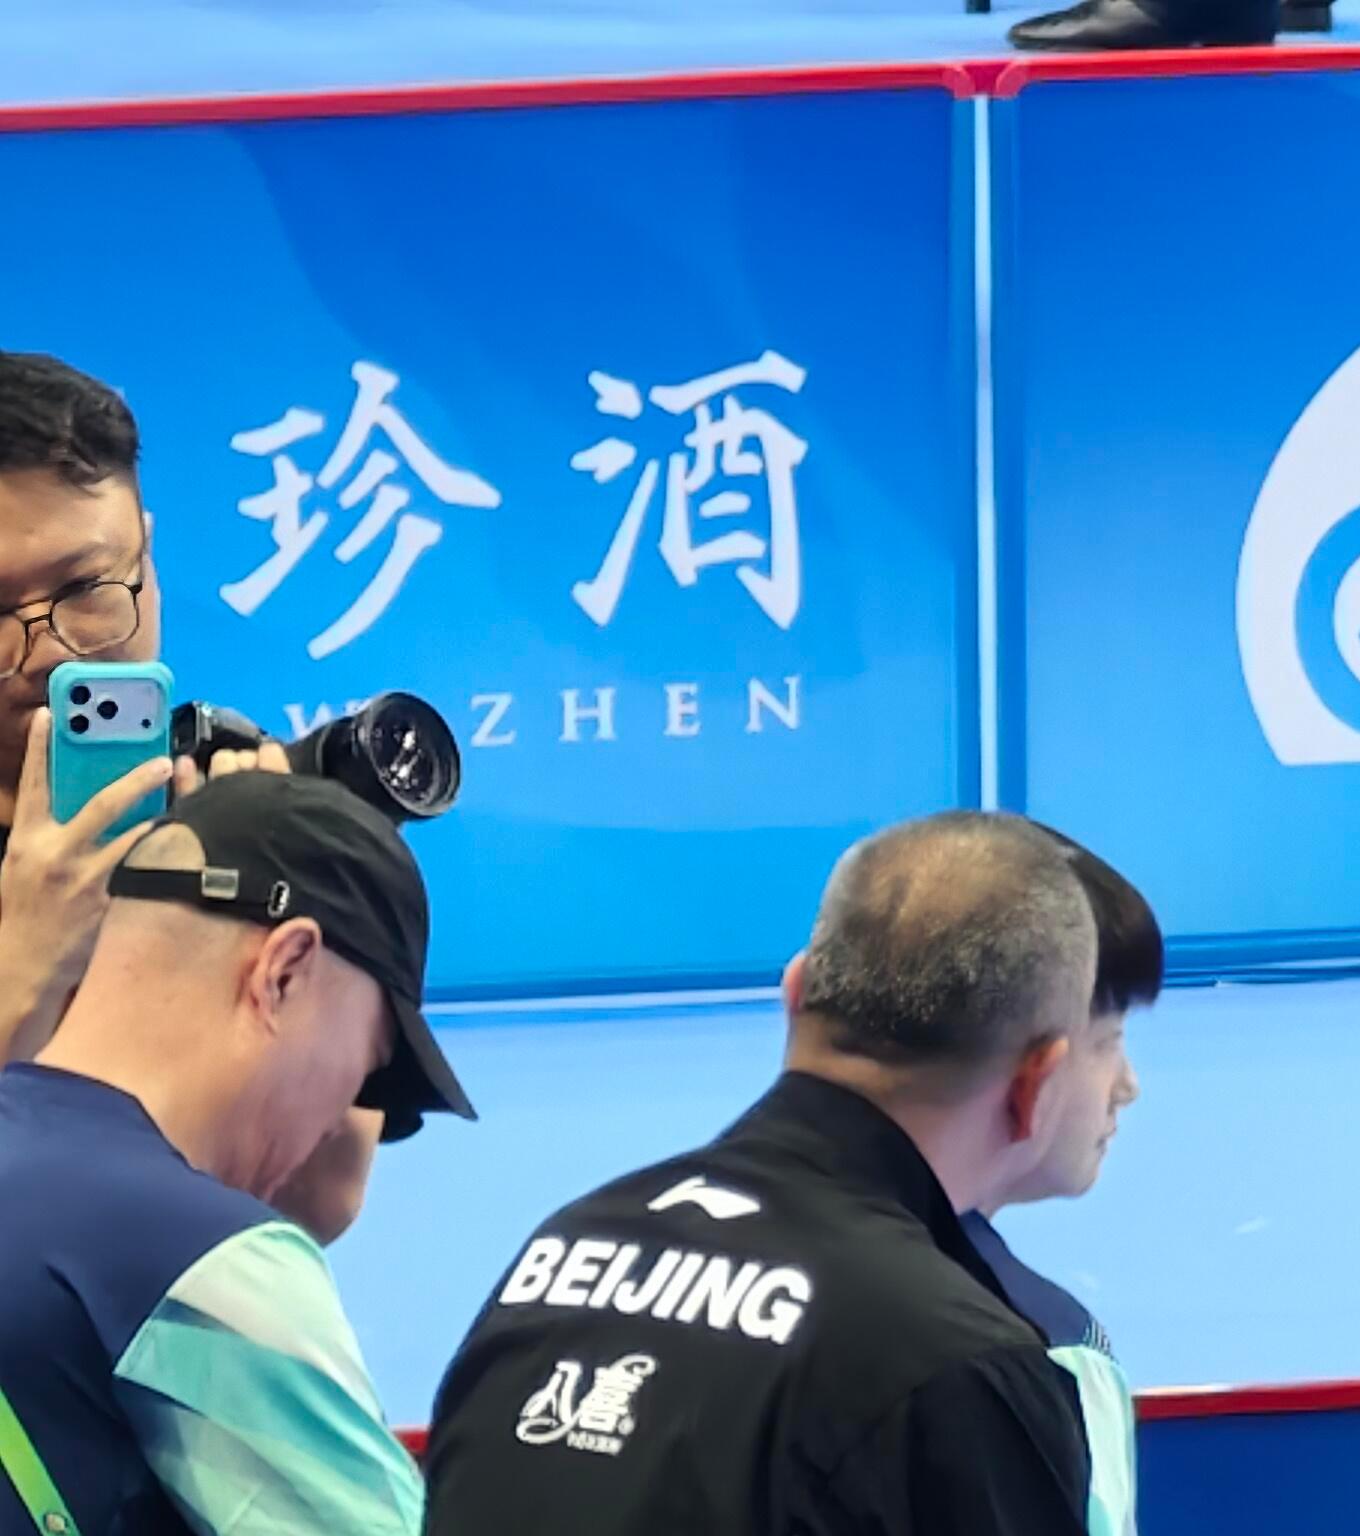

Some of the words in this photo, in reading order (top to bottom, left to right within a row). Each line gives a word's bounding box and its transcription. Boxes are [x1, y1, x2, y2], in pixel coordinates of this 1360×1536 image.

[219, 350, 807, 660] 珍酒
[470, 676, 801, 748] ZHEN
[500, 1236, 813, 1346] BEIJING
